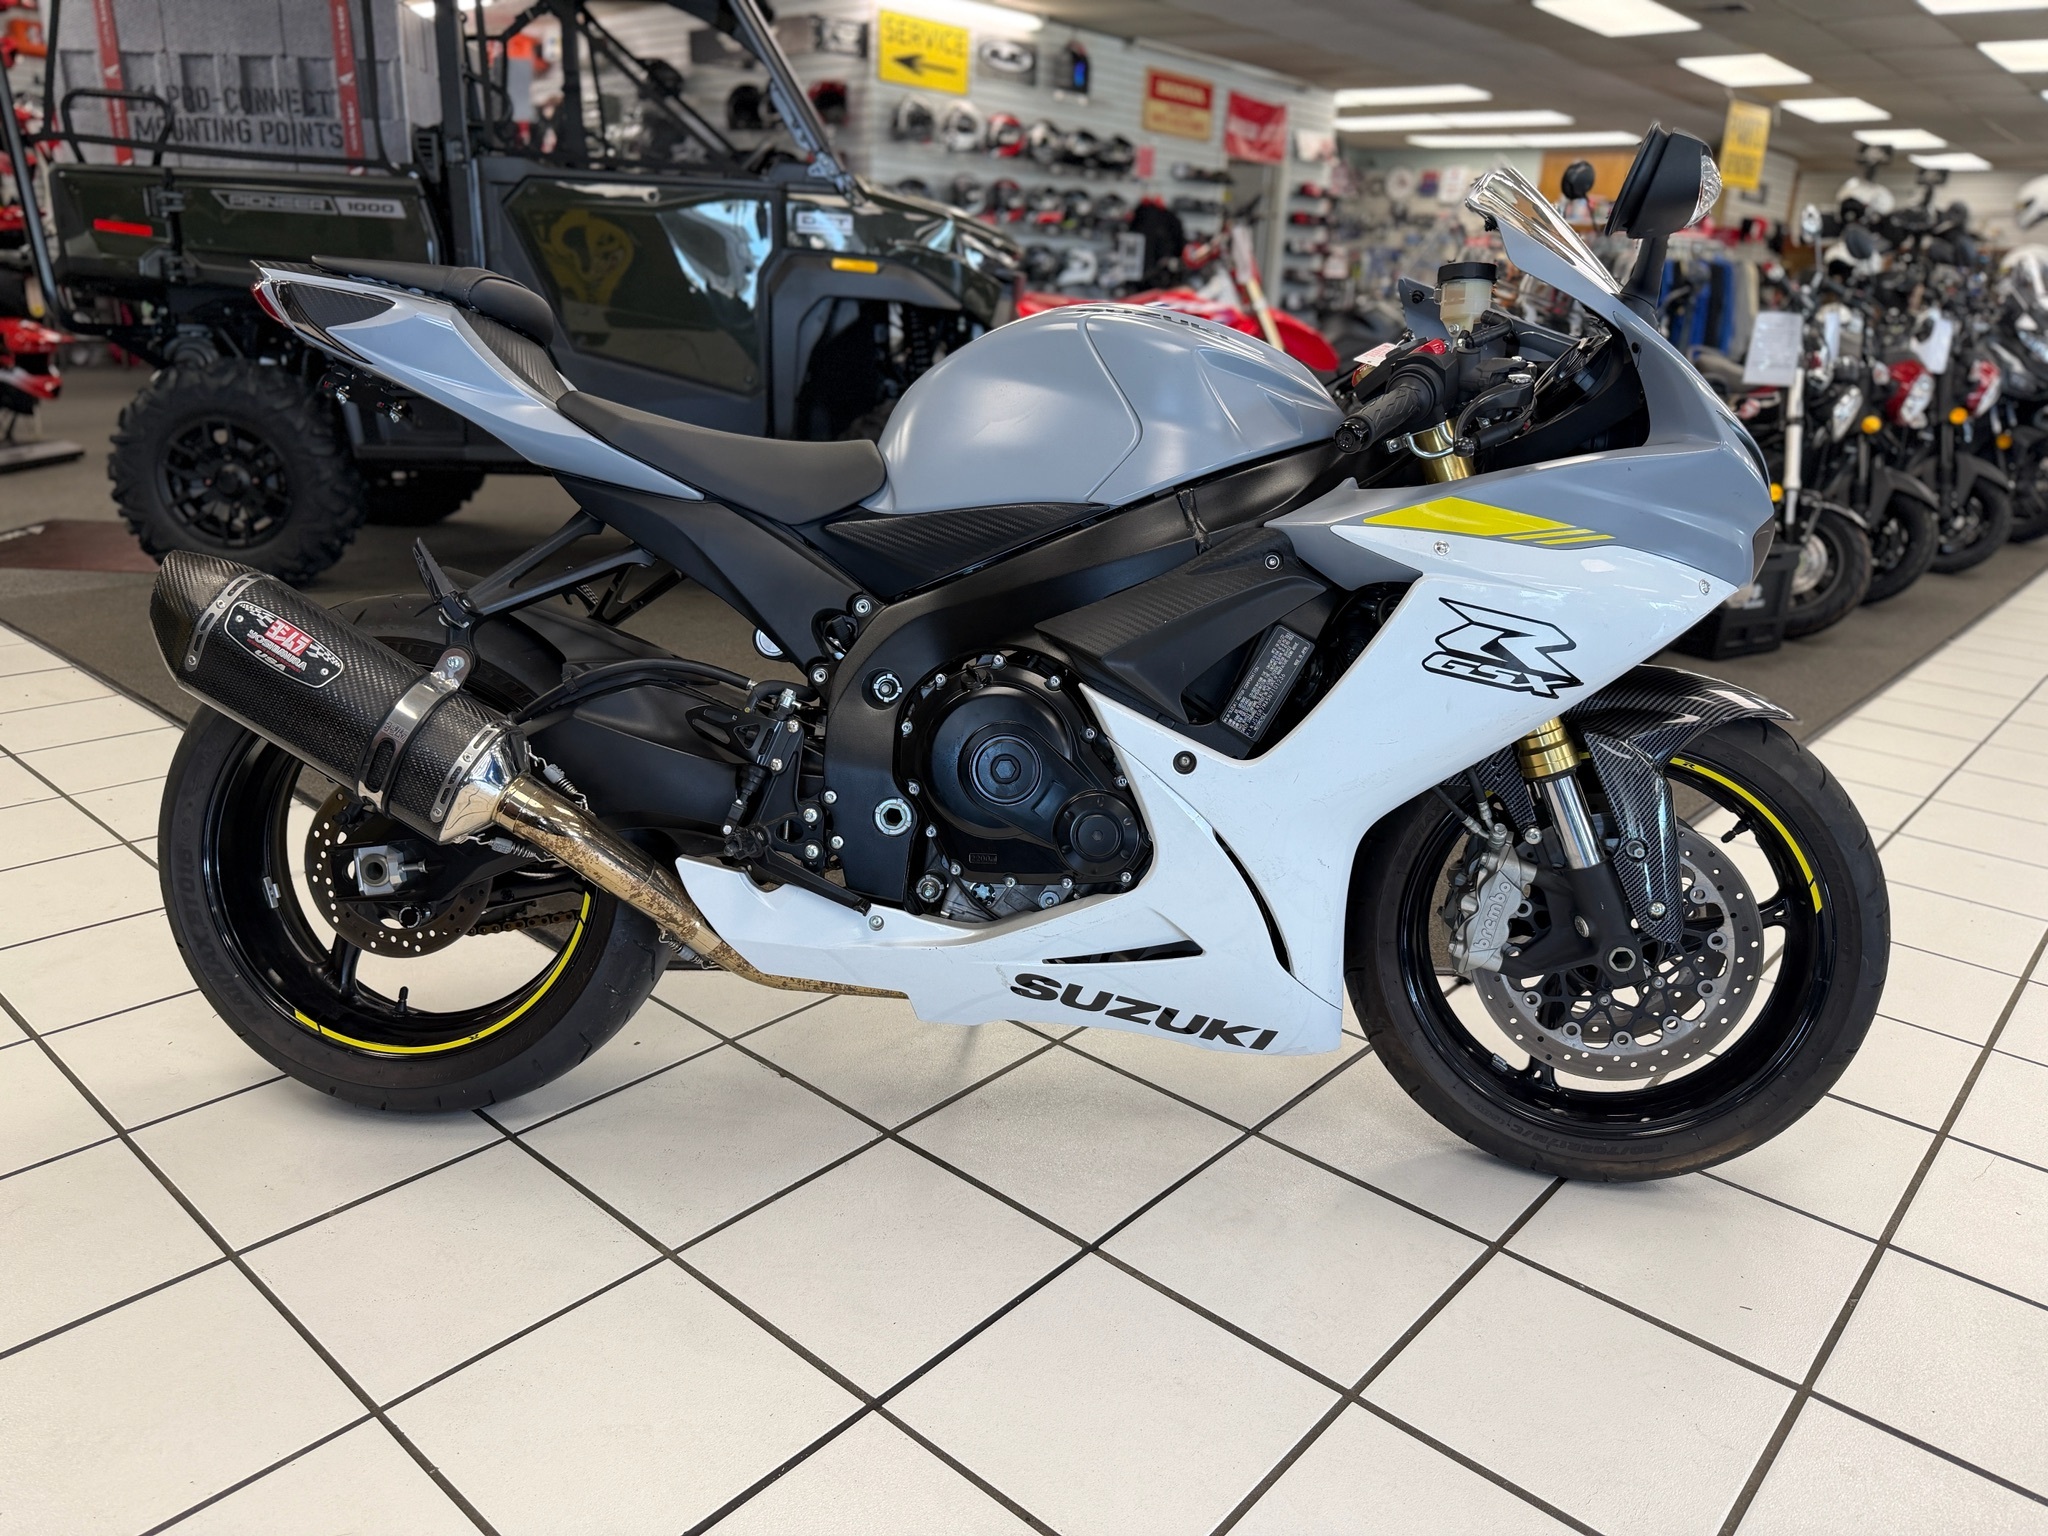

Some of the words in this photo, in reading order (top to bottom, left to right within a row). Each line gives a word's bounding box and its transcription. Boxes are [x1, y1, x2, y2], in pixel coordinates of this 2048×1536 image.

[886, 18, 966, 58] SERVICE
[259, 120, 344, 149] POINTS
[347, 202, 395, 213] 1000
[247, 629, 308, 672] YOSHIMURA
[254, 649, 286, 671] USA
[1472, 881, 1512, 949] brembo
[1010, 973, 1279, 1051] SUZUKI
